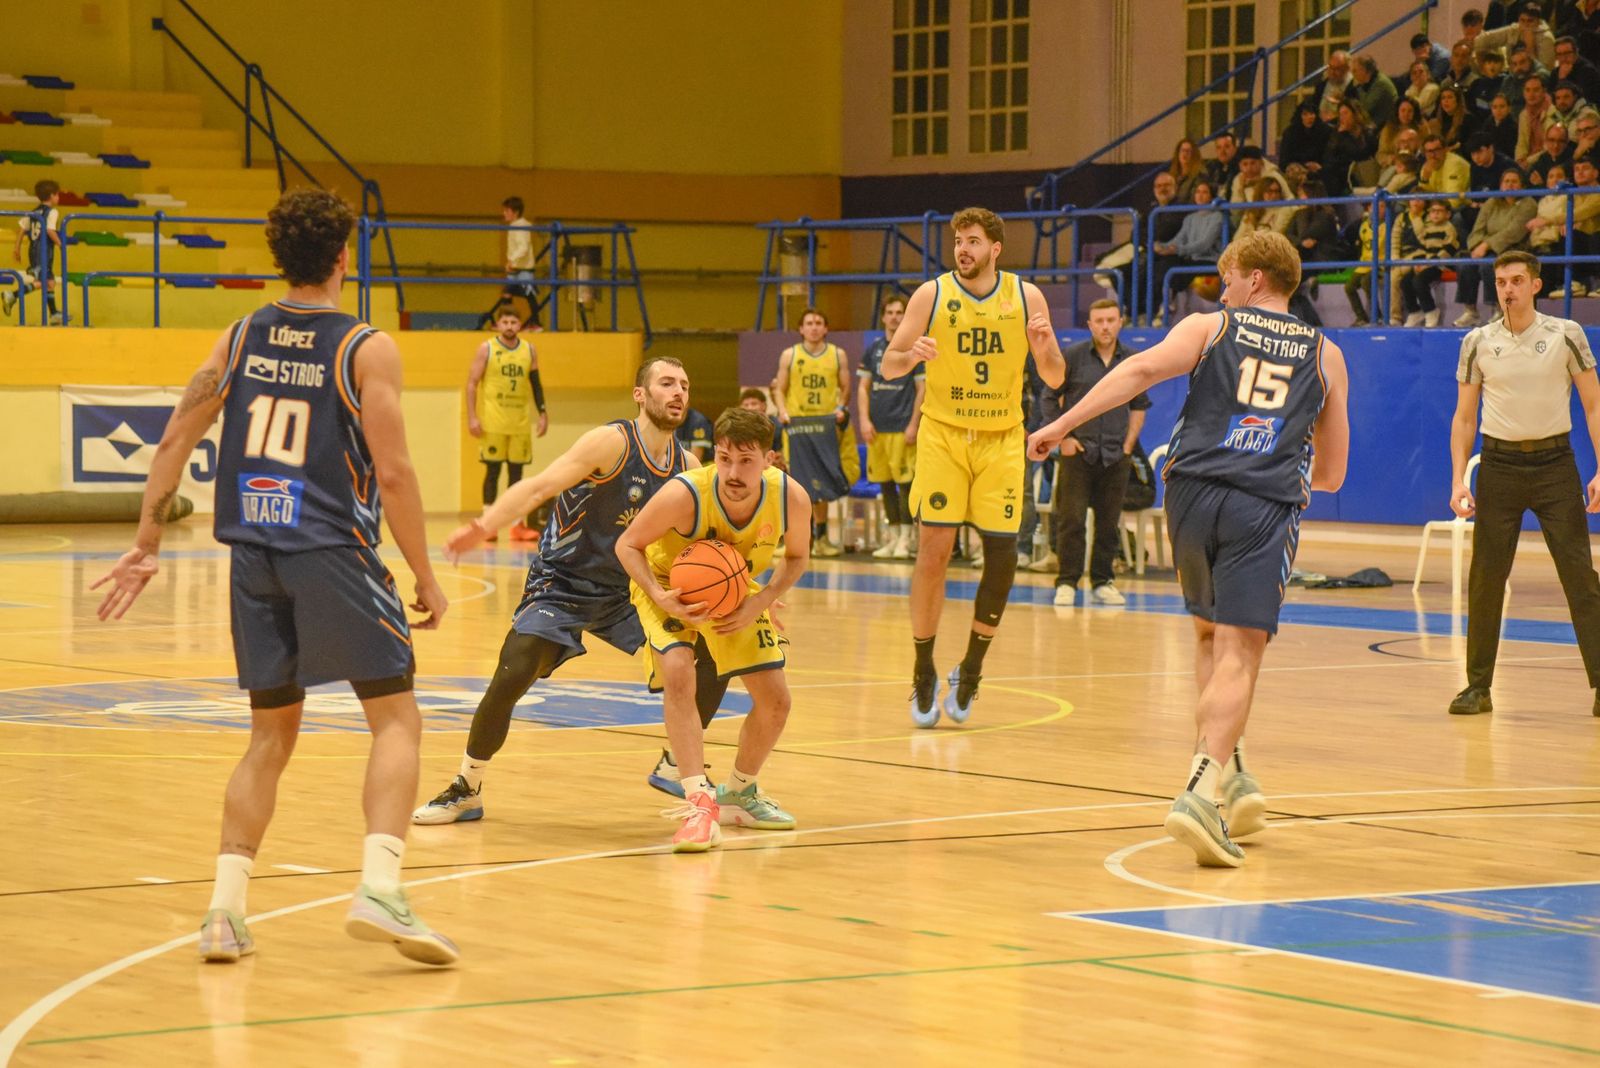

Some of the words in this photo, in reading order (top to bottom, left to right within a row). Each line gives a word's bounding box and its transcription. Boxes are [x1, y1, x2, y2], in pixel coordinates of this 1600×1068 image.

[268, 324, 317, 350] LÓPEZ
[957, 327, 1005, 356] CBA
[1262, 336, 1309, 360] STROG
[279, 360, 326, 388] STROG
[510, 379, 517, 391] 7
[802, 374, 827, 389] CBA
[975, 361, 989, 385] 9
[1236, 355, 1295, 411] 15
[808, 391, 821, 405] 21
[955, 407, 1009, 418] ALGECIRAS
[244, 394, 312, 469] 10
[1004, 504, 1014, 519] 9
[756, 629, 776, 649] 15
